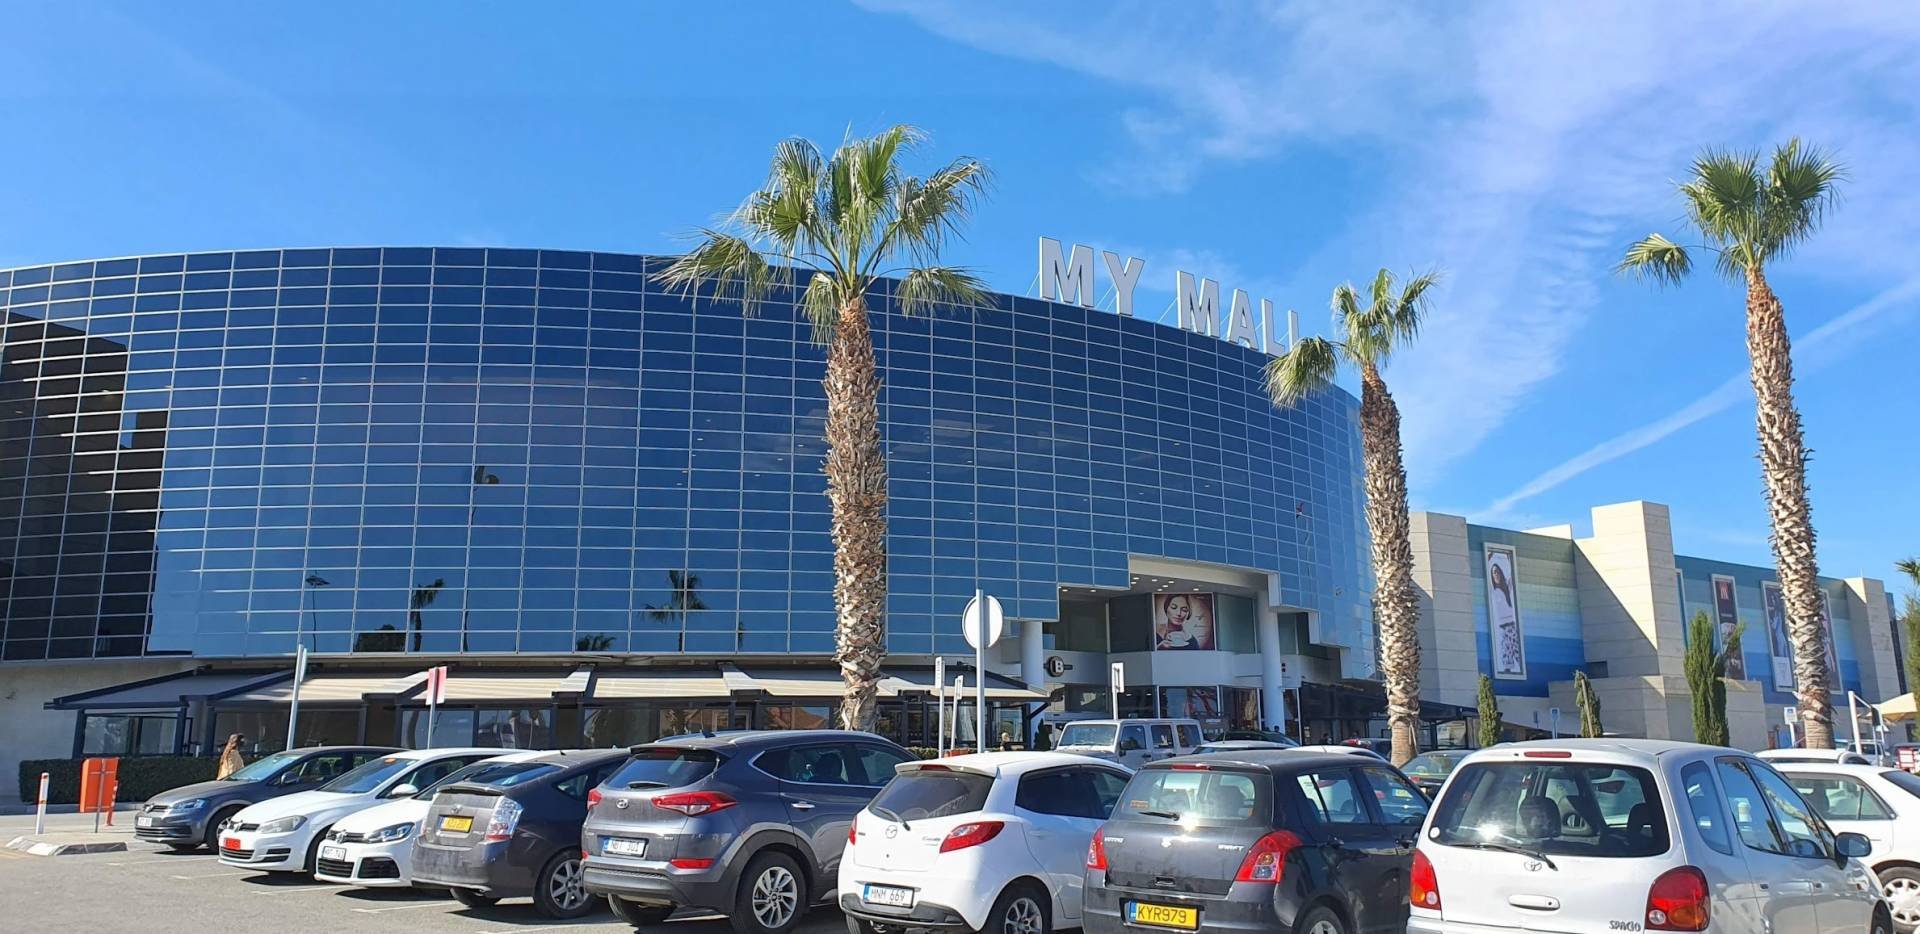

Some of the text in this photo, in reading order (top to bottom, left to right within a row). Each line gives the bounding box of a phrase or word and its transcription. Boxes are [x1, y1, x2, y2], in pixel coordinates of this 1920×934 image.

[1039, 236, 1300, 356] MY MALL
[1137, 905, 1187, 924] KYR979
